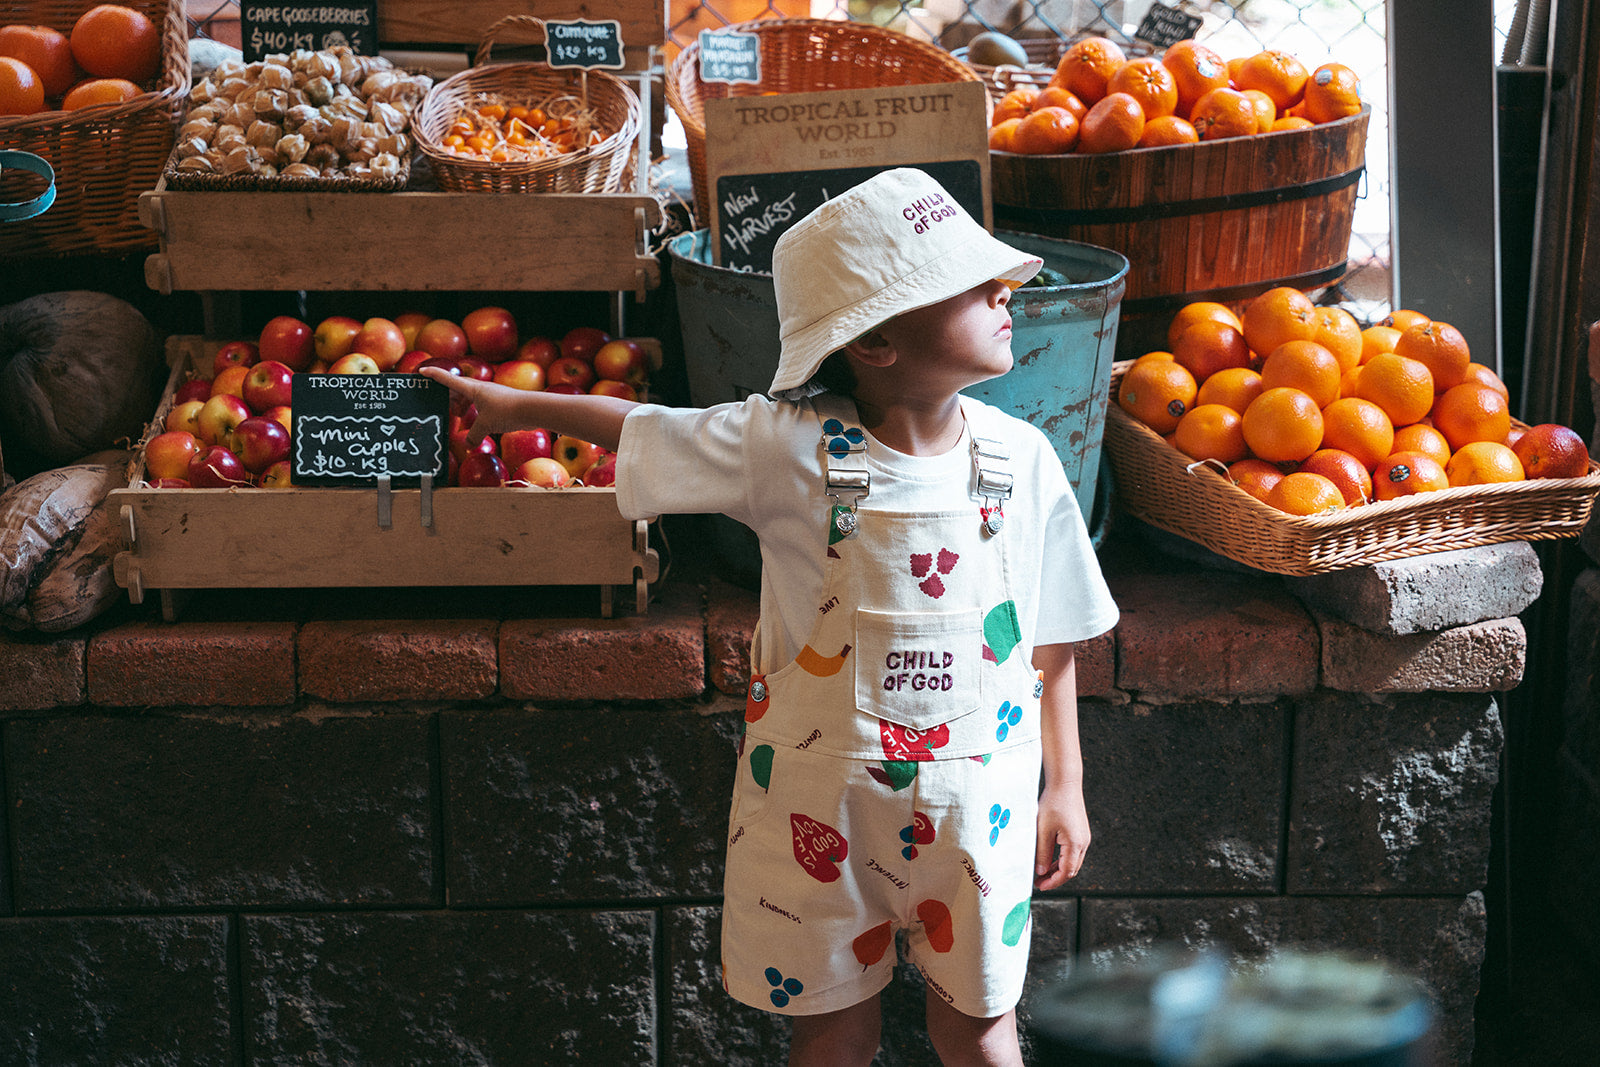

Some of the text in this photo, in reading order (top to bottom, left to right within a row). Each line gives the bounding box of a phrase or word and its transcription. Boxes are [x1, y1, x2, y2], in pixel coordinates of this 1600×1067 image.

[246, 6, 370, 27] CAPE GOOSEBERRIES
[735, 94, 954, 126] TROPICAL FRUIT
[795, 121, 898, 145] WORLD
[723, 185, 760, 218] NEW
[902, 192, 945, 222] CHILD
[308, 377, 433, 390] TROPICAL FRUIT
[818, 595, 840, 615] LOVE
[885, 650, 955, 670] CHILD
[803, 832, 840, 870] GOD IS
[865, 858, 910, 890] PATIENCE
[960, 857, 992, 897] PATIENCE
[759, 896, 802, 924] KINDNESS
